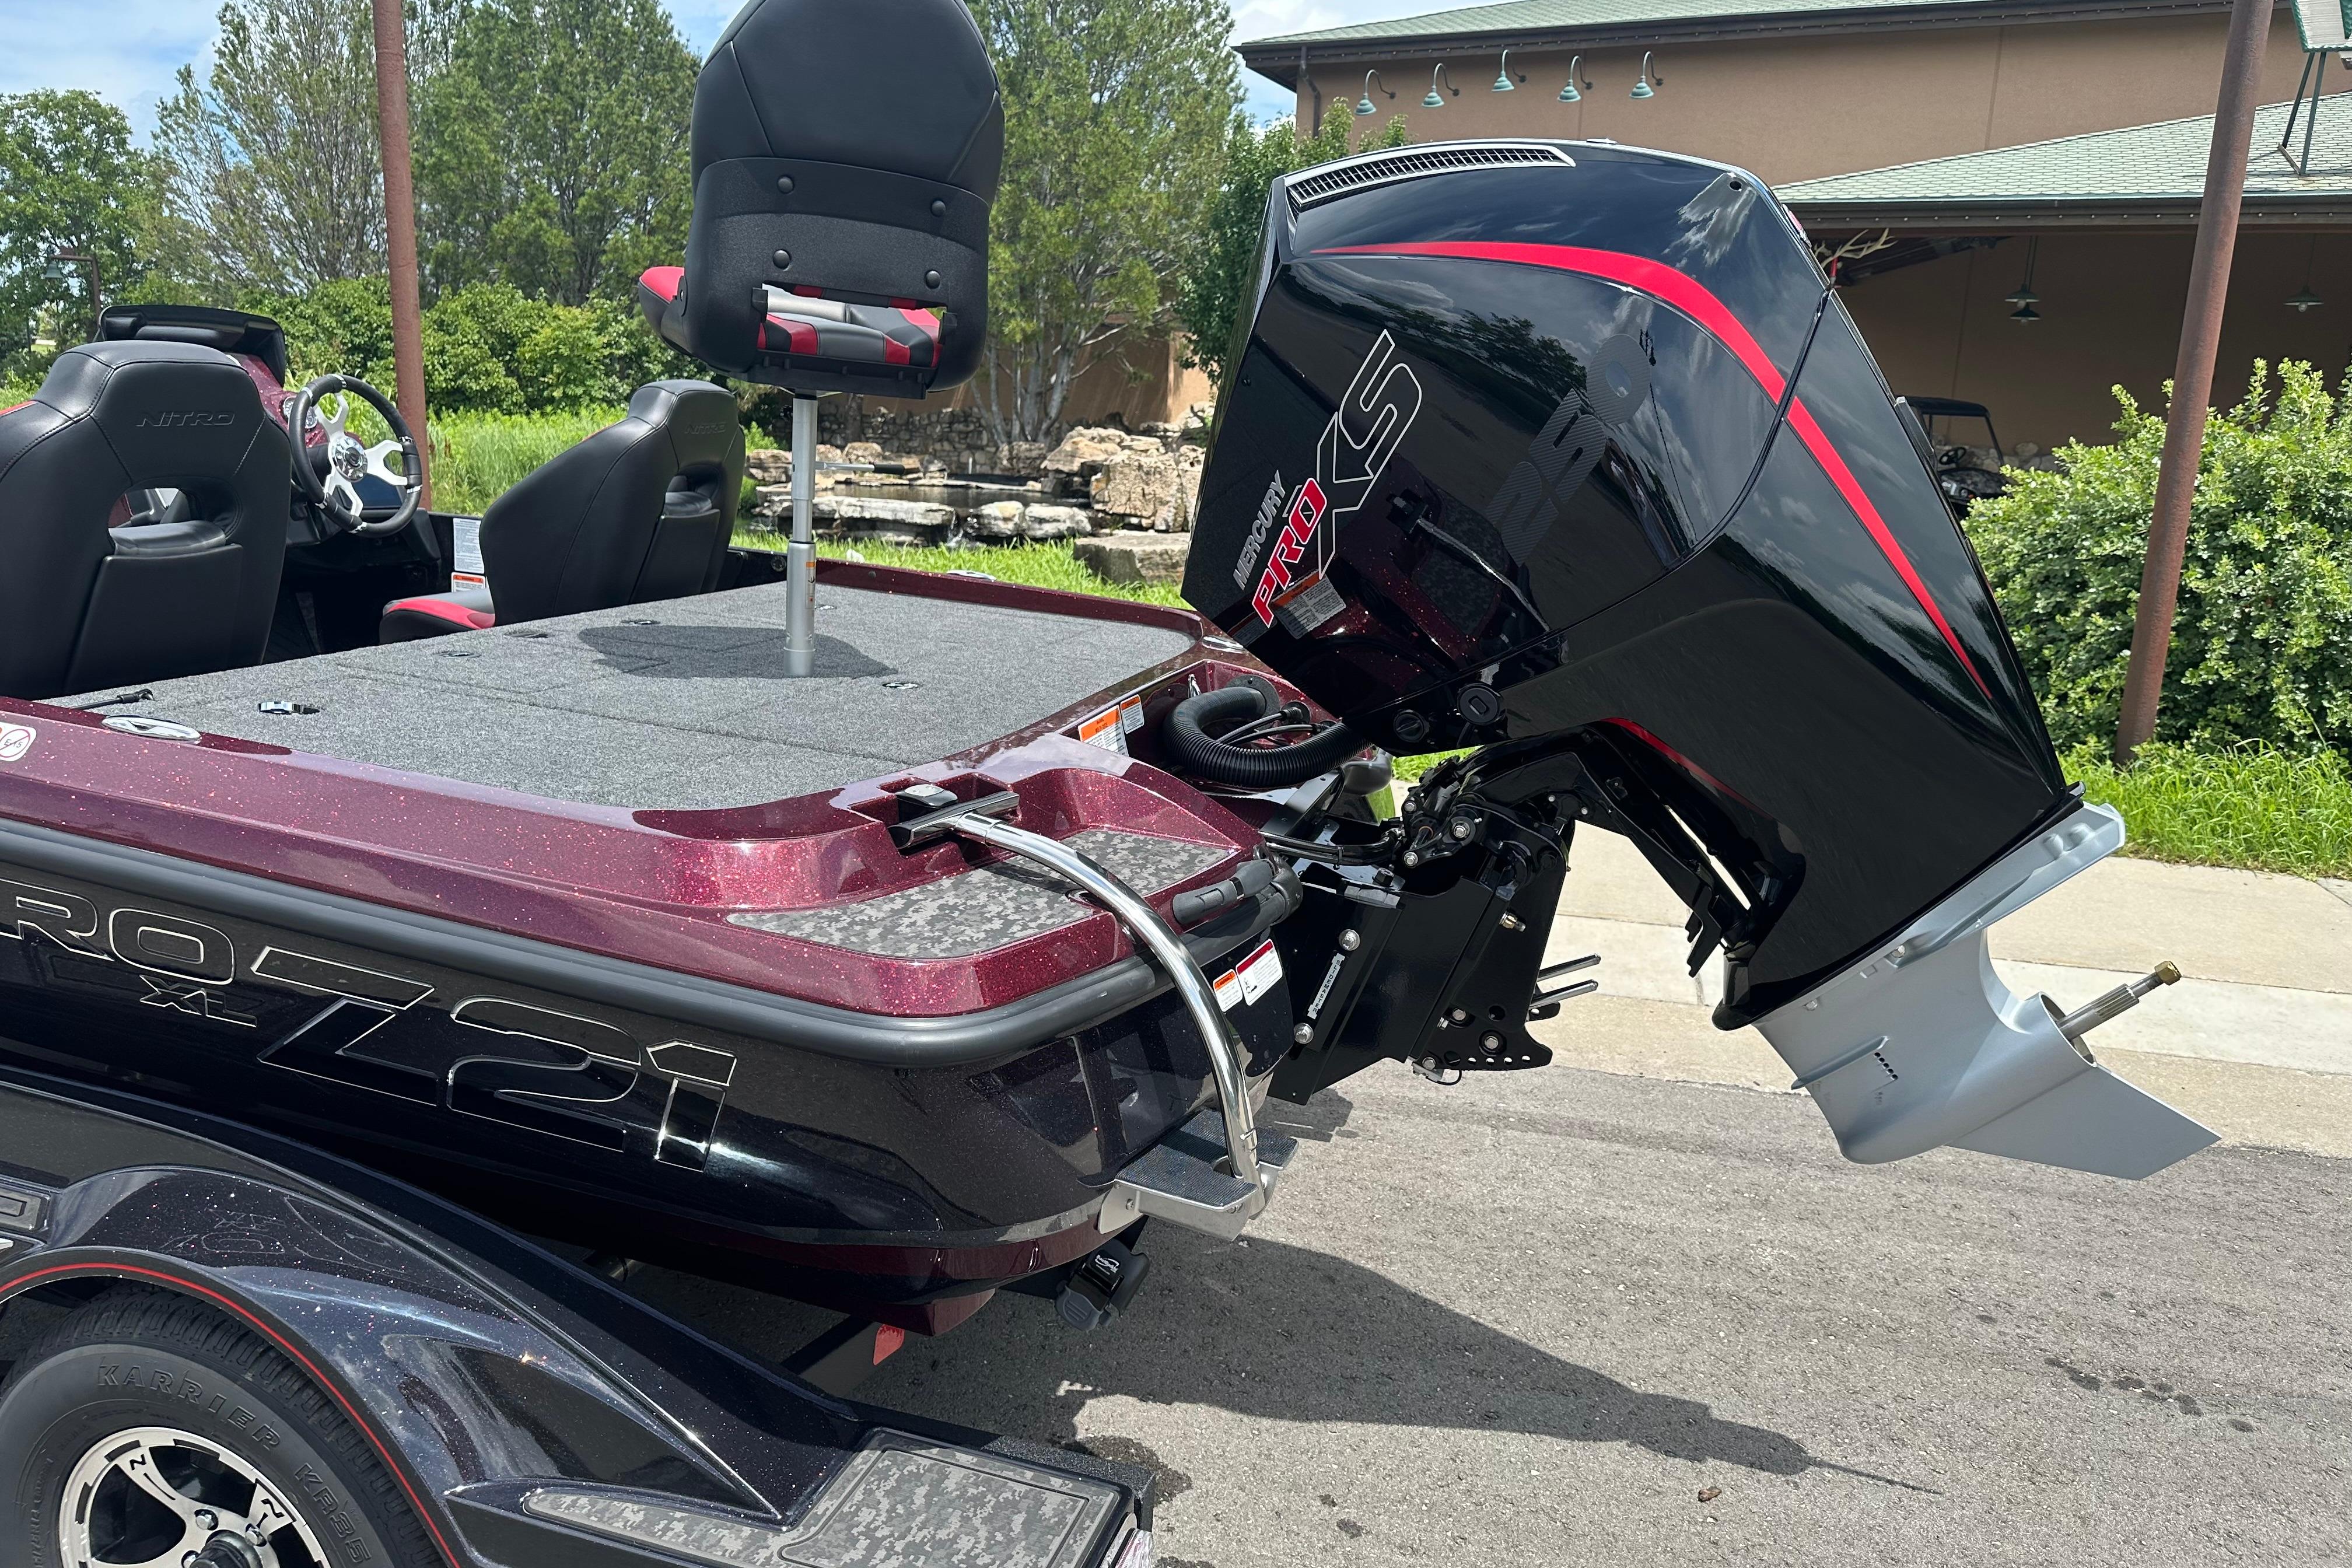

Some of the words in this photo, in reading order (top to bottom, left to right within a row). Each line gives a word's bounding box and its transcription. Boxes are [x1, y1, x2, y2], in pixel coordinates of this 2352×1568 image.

[135, 411, 236, 427] NITRO
[1485, 333, 1651, 568] 250
[1252, 477, 1327, 628] PRO
[1316, 328, 1422, 580] XS
[1232, 470, 1286, 591] MERCURY
[1312, 960, 1340, 1013] SLIDEMASTER
[97, 1364, 281, 1451] KARRIER
[294, 1462, 372, 1563] KR35
